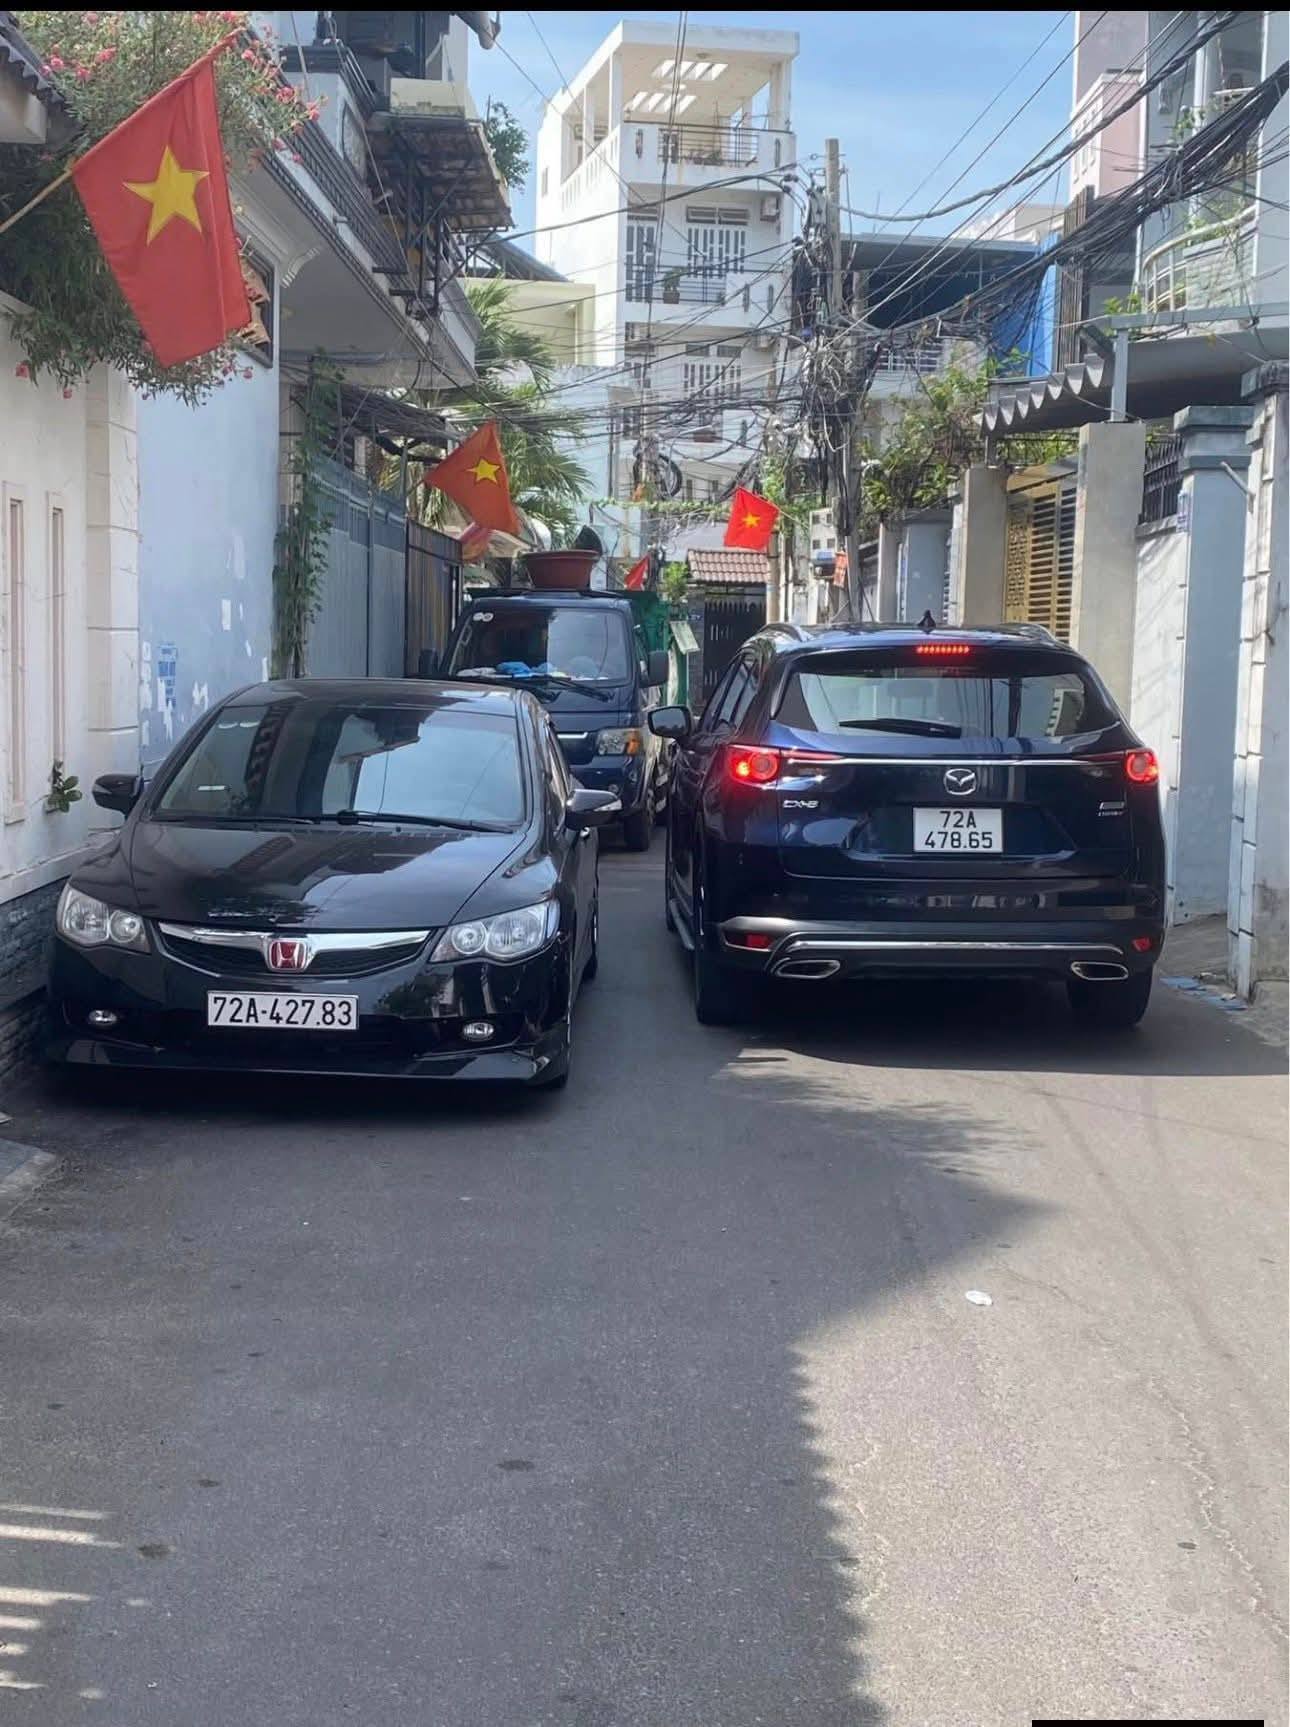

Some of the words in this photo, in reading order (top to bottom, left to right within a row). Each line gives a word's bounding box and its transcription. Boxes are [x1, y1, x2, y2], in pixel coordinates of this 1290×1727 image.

[939, 810, 977, 829] 72A
[924, 831, 993, 849] 478.65
[213, 996, 352, 1026] 72A-427.83
